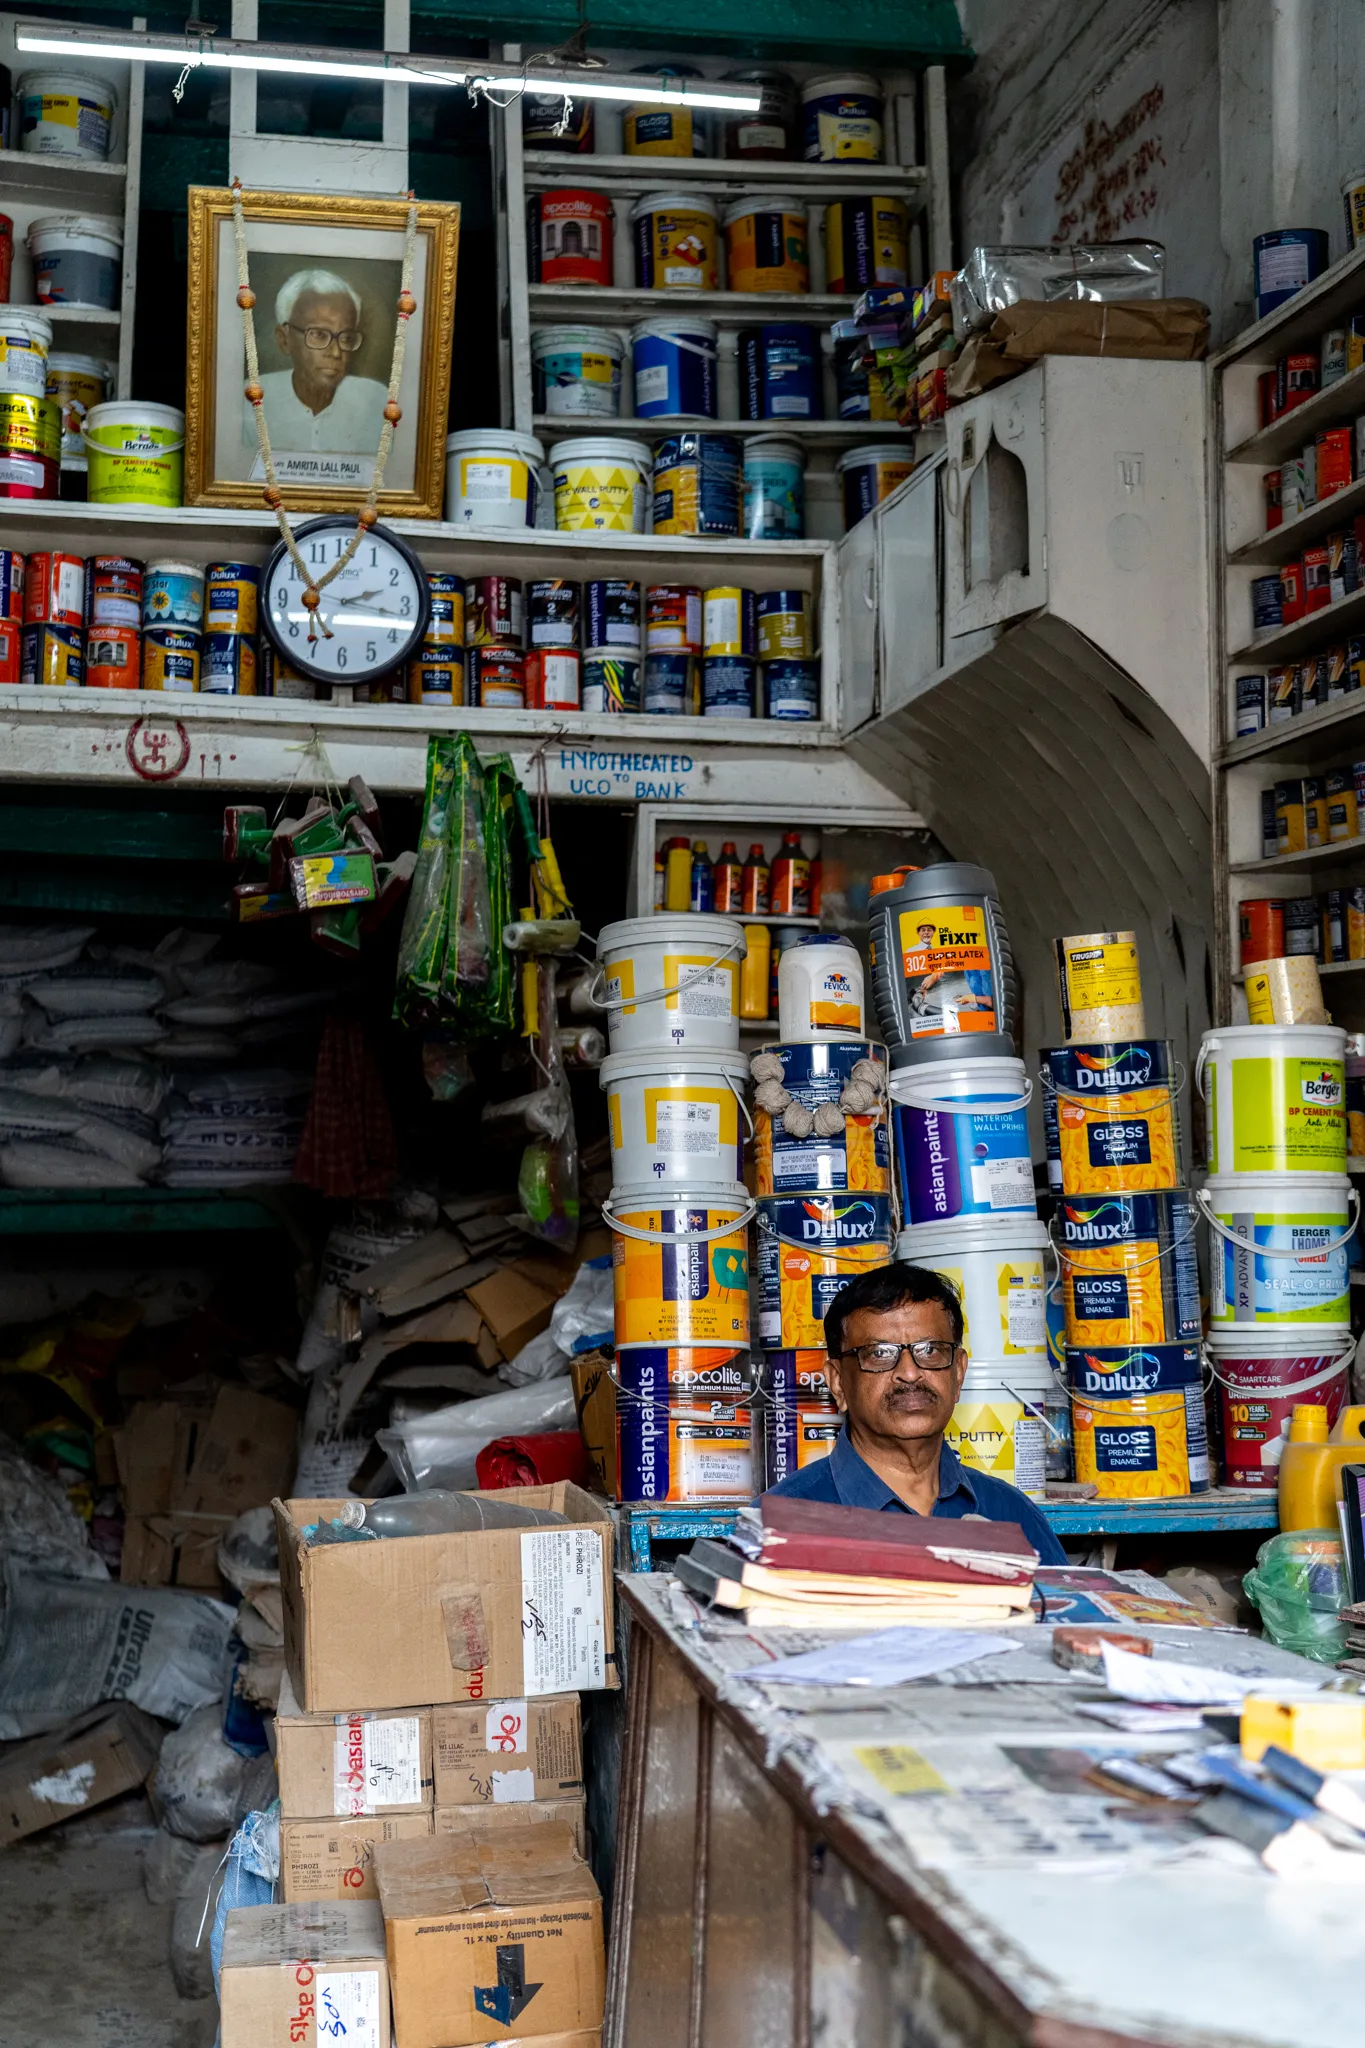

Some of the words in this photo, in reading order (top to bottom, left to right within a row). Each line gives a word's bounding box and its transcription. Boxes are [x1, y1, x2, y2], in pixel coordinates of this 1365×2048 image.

[853, 212, 870, 284] asianpaints
[747, 340, 760, 420] asianpaints
[287, 460, 318, 470] AMRITA
[321, 462, 338, 472] LALL
[341, 463, 361, 473] PAUL
[600, 486, 629, 495] PUTTY
[310, 543, 327, 564] 11
[370, 547, 378, 568] 1
[211, 571, 236, 581] Dulux
[389, 568, 399, 587] 2
[152, 579, 169, 591] Star
[211, 591, 236, 599] GLOSS
[278, 588, 288, 609] 9
[400, 596, 411, 616] 3
[547, 602, 556, 614] 2
[589, 583, 602, 647] asianpaints
[165, 636, 192, 648] Dulux
[387, 628, 398, 643] 4
[310, 639, 319, 659] 7
[366, 641, 377, 662] 5
[166, 658, 193, 668] GLOSS
[337, 647, 347, 668] 6
[422, 654, 450, 662] Dulux
[561, 750, 693, 773] HYPOTHECATED
[614, 772, 630, 783] TO
[570, 778, 611, 796] UCO
[635, 780, 686, 799] BANK
[940, 933, 978, 946] FIXIT
[906, 955, 926, 973] 302
[927, 951, 957, 962] SUPER
[958, 950, 984, 959] LATEX
[824, 981, 852, 993] FEVICOL
[1076, 1068, 1144, 1089] Dulux
[1305, 1081, 1340, 1099] Berger
[973, 1114, 1013, 1123] INTERIOR
[1289, 1107, 1300, 1116] BP
[1302, 1107, 1332, 1117] CEMENT
[974, 1123, 1000, 1132] WALL
[1001, 1123, 1025, 1131] PRIMER
[1093, 1126, 1144, 1140] GLOSS
[1103, 1143, 1138, 1151] PREMIUM
[924, 1110, 950, 1212] asianpaints
[1105, 1152, 1137, 1160] ENAMEL
[803, 1219, 870, 1240] Dulux
[1065, 1221, 1122, 1241] Dulux
[1292, 1228, 1331, 1238] BERGER
[1297, 1237, 1326, 1250] HOME
[688, 1228, 704, 1297] asianpains
[1238, 1225, 1249, 1289] ADVANED
[1077, 1280, 1121, 1294] GLOSS
[1239, 1294, 1249, 1308] XP
[1085, 1306, 1114, 1314] ENAMEL
[671, 1366, 742, 1390] apcolite
[1085, 1371, 1151, 1392] Dulux
[1239, 1375, 1282, 1384] SMARTCARE
[1231, 1405, 1249, 1422] 10
[1249, 1405, 1265, 1413] YEARS
[637, 1366, 664, 1496] asianpaints
[773, 1369, 794, 1480] sianpaints
[960, 1431, 1003, 1442] PUTTY
[1099, 1431, 1150, 1446] GLOSS
[1107, 1449, 1143, 1457] PREMIUM
[1110, 1458, 1142, 1466] ENAMEL
[575, 1532, 583, 1546] PGE
[576, 1547, 584, 1575] PHIROZI
[485, 1920, 500, 1930] direct
[509, 1918, 526, 1926] meant
[526, 1917, 536, 1926] Not
[540, 1914, 562, 1925] Package
[486, 1934, 498, 1943] 6N
[506, 1930, 545, 1941] Quantity
[547, 1928, 562, 1938] Net
[464, 1937, 475, 1945] 1L
